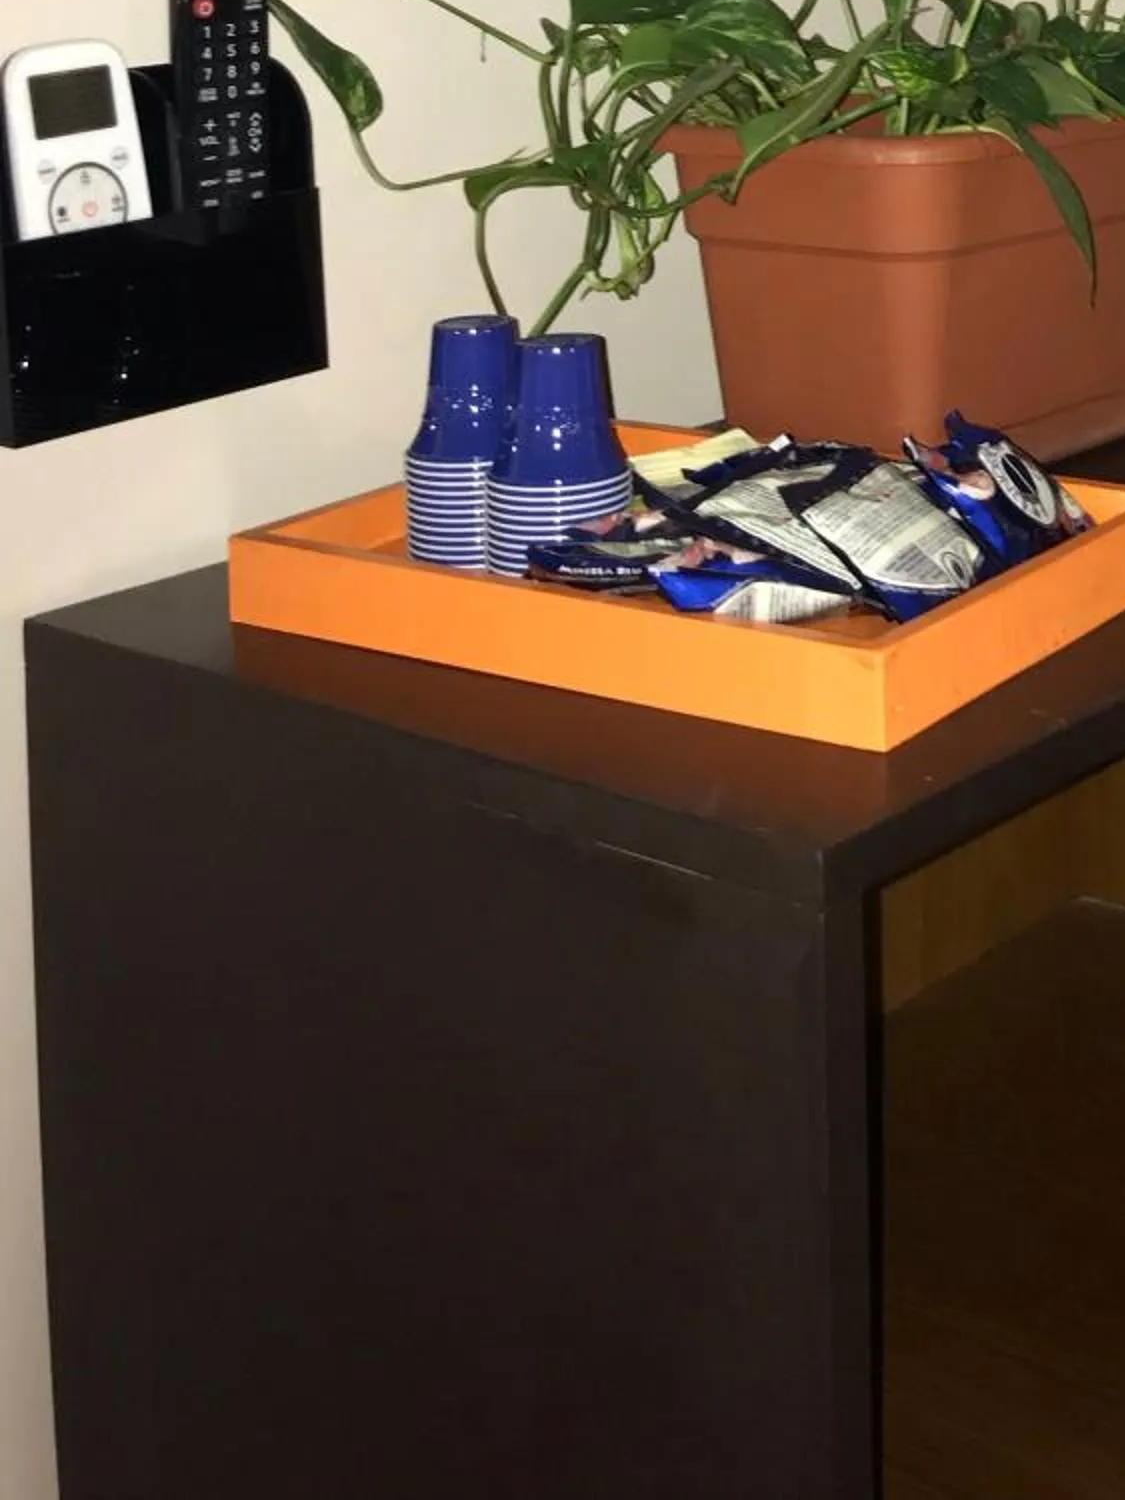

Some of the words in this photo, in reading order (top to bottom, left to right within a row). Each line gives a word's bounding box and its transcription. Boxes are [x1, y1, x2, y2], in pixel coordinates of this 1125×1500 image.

[203, 25, 211, 39] 1
[226, 23, 237, 37] 2
[249, 19, 260, 34] 3
[201, 46, 213, 59] 4
[226, 43, 237, 57] 5
[250, 40, 261, 55] 6
[202, 67, 213, 81] 7
[226, 65, 238, 79] 8
[250, 61, 261, 75] 9
[227, 85, 238, 99] 0
